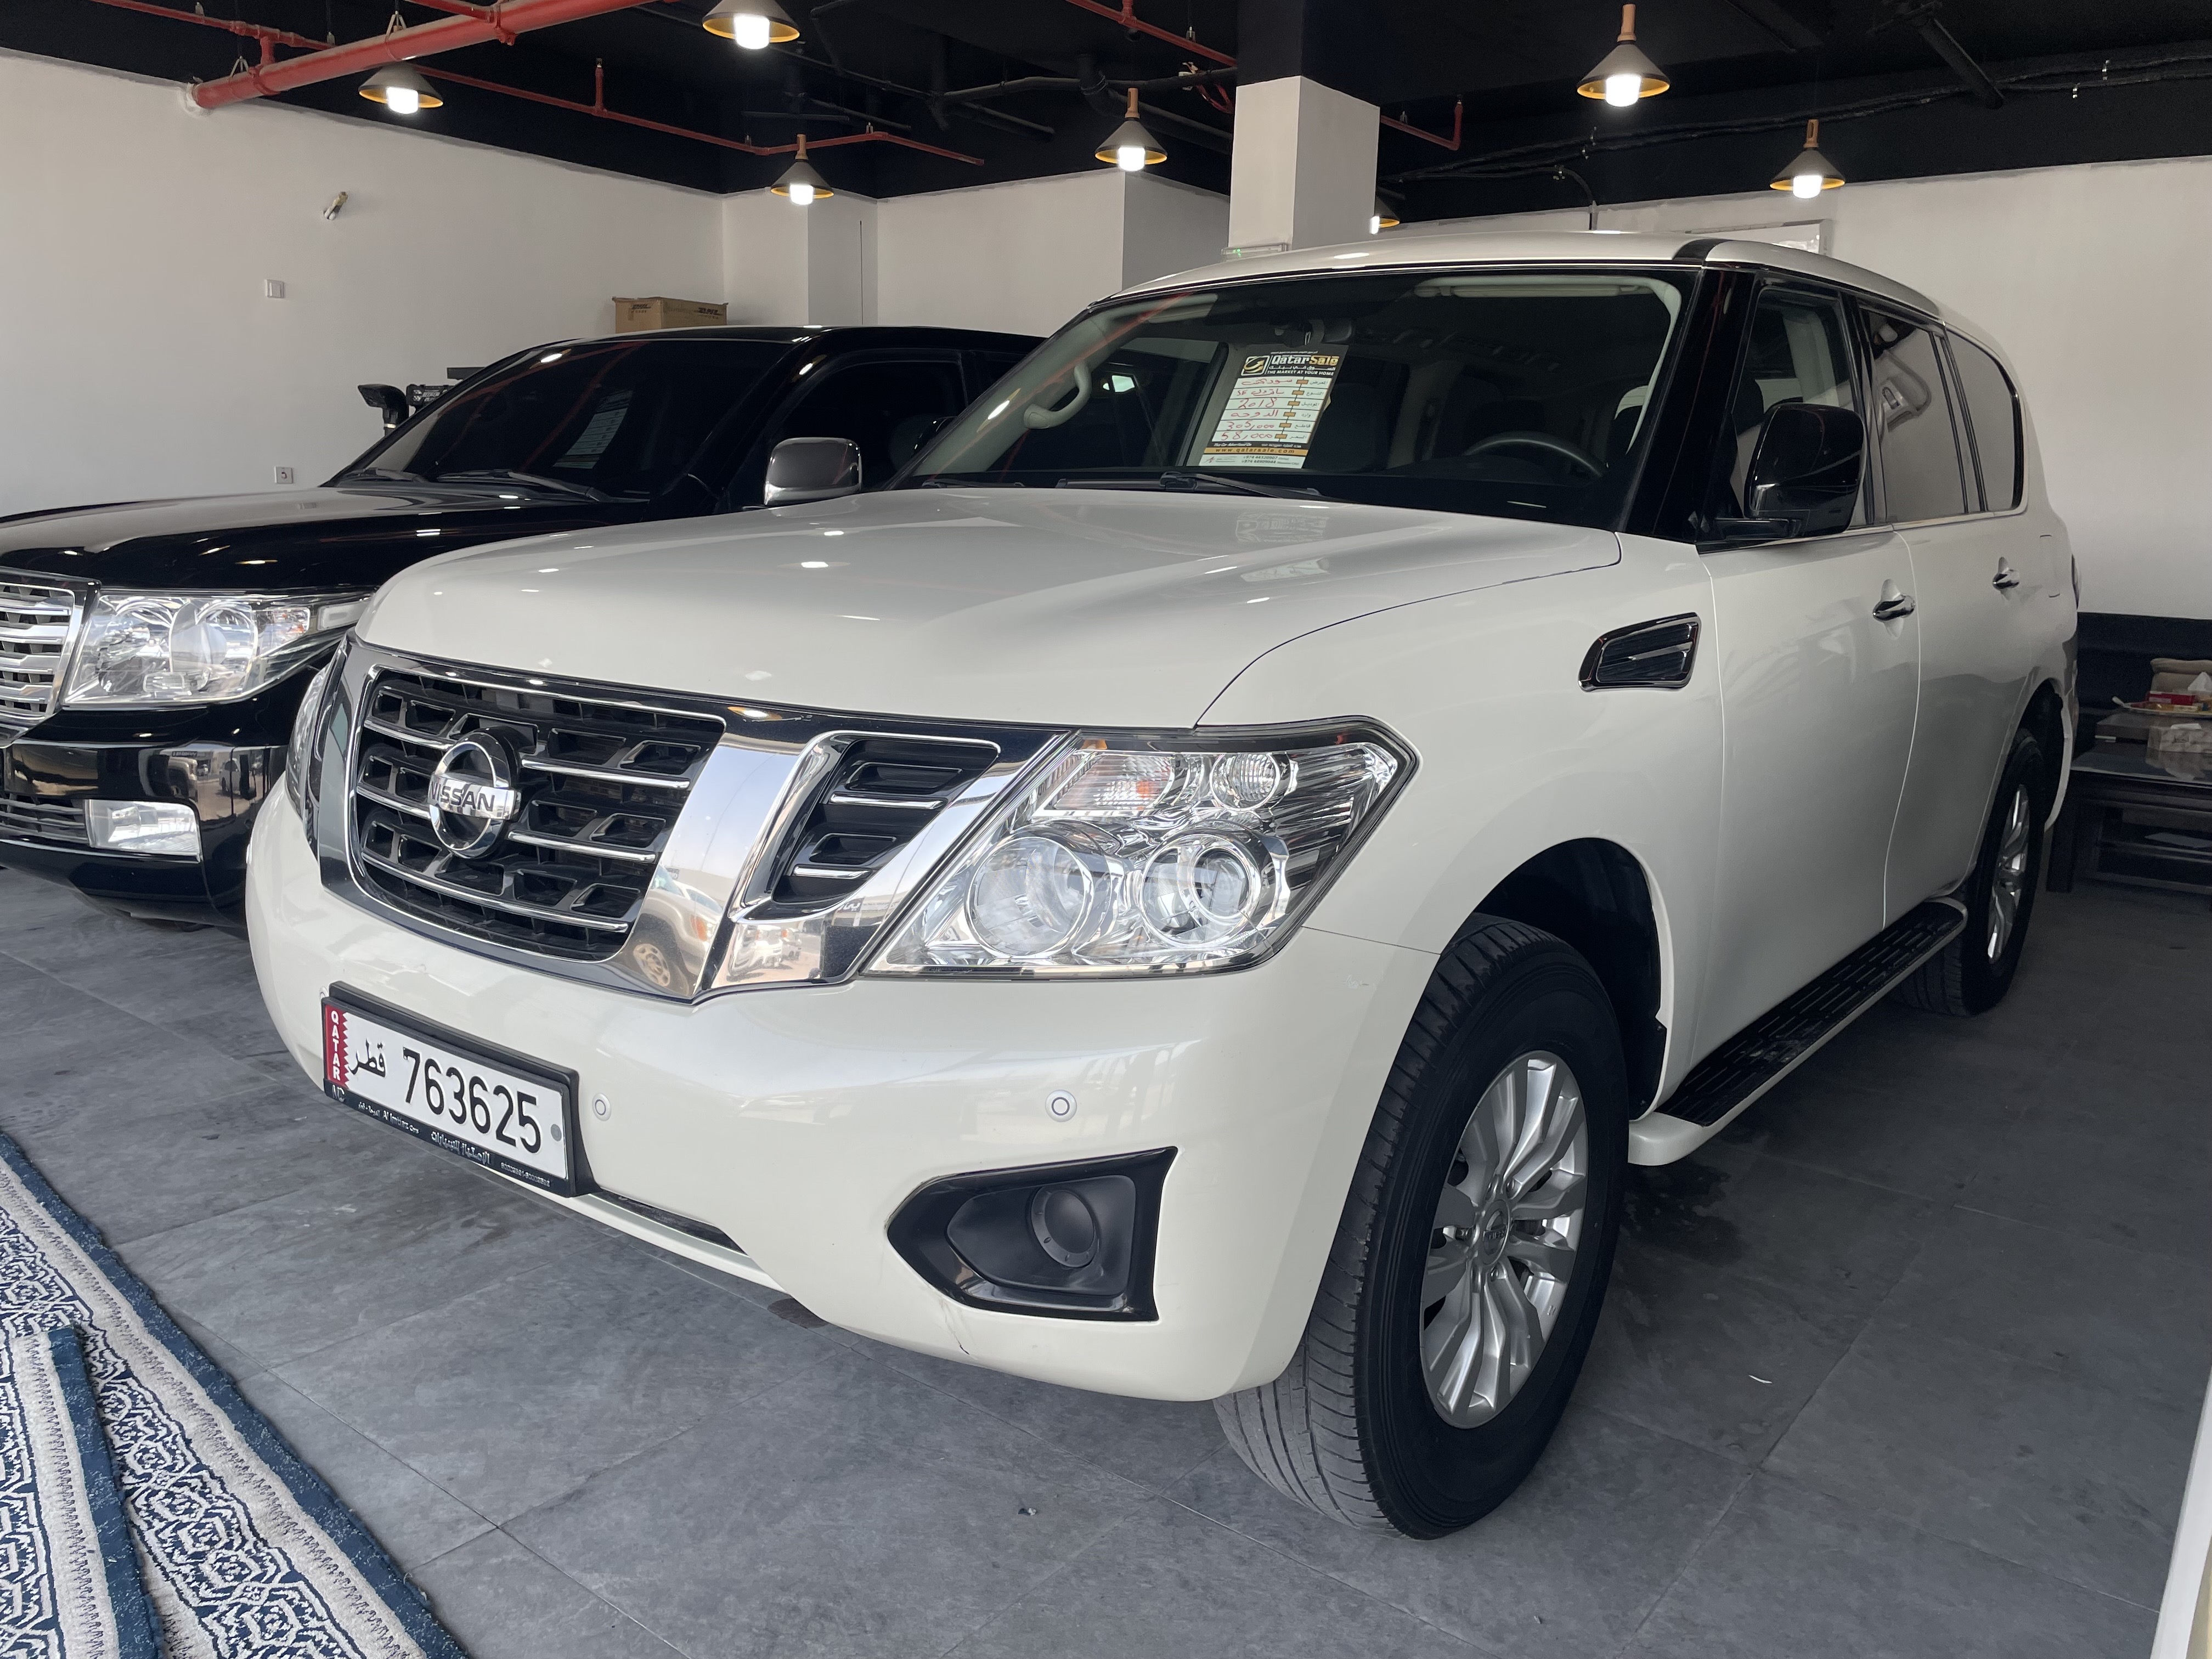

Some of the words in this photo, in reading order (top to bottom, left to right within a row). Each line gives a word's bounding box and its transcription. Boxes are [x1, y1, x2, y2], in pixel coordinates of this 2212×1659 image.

[1271, 354, 1340, 366] QatarSale
[1238, 398, 1277, 409] 2018
[431, 781, 495, 812] NISSAN
[331, 1010, 341, 1082] QATAR
[348, 1038, 386, 1078] قطر
[402, 1046, 541, 1154] 763625
[383, 1110, 389, 1121] Al
[390, 1113, 409, 1129] Imtiaz
